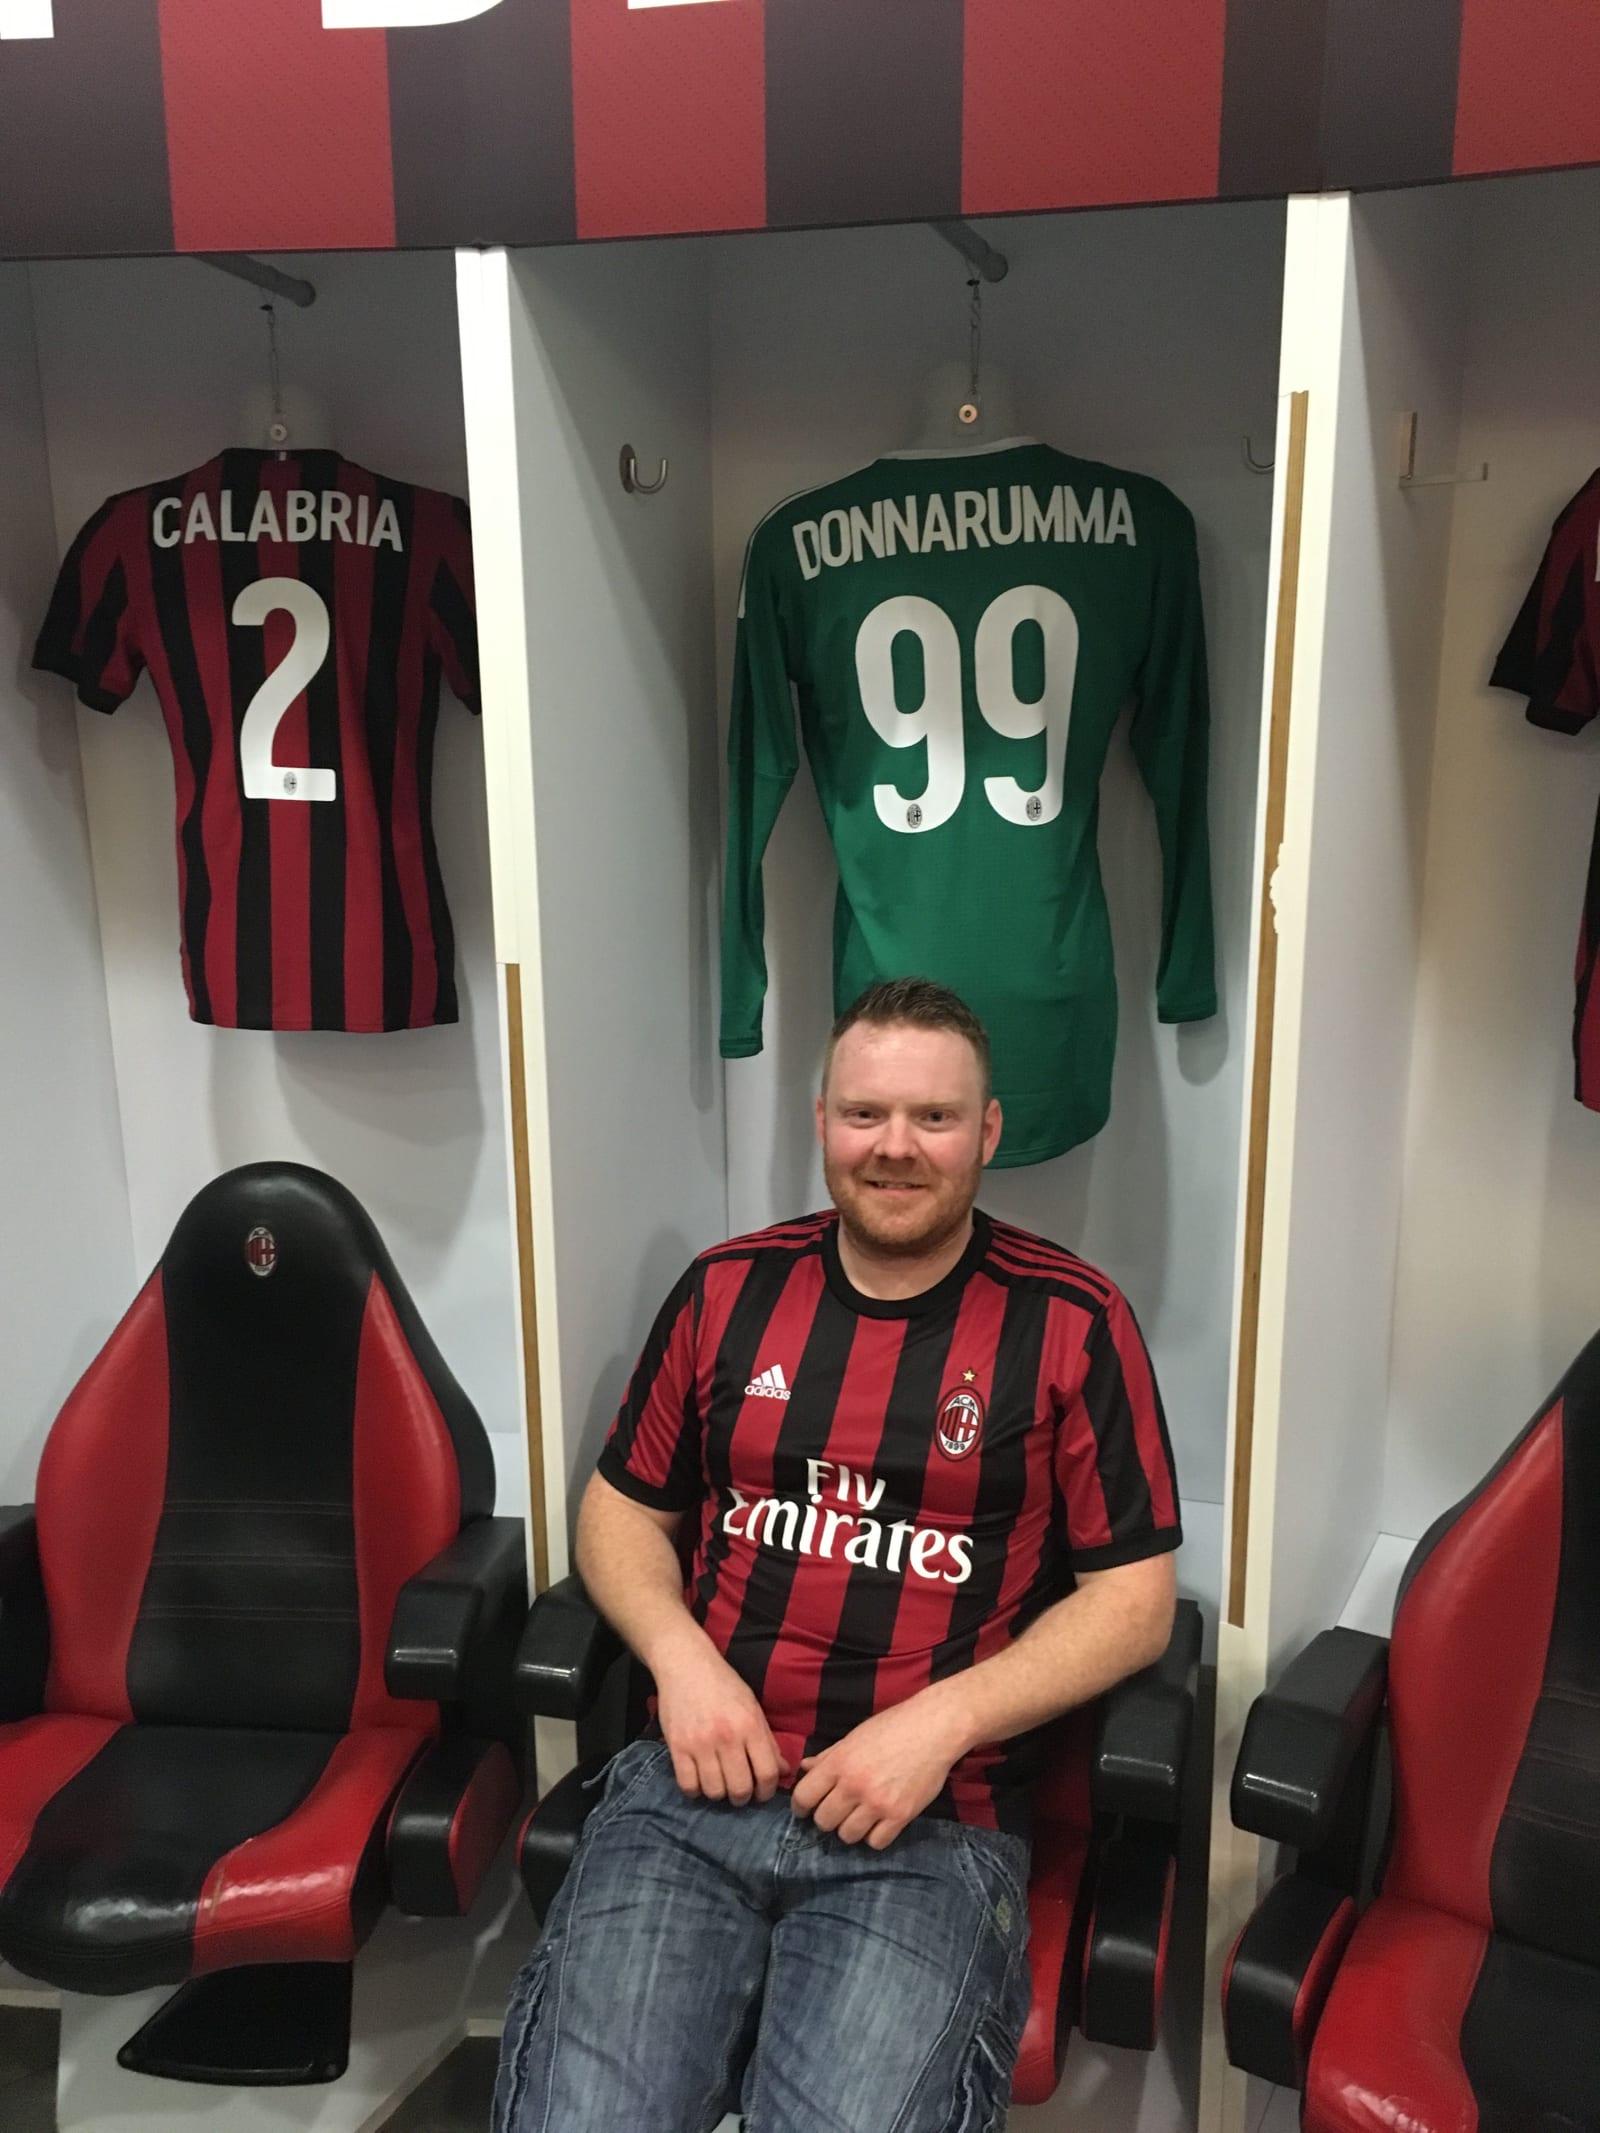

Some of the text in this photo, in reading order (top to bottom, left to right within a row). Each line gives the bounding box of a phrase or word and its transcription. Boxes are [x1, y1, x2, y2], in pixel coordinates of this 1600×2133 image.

[152, 490, 403, 552] CALABRIA
[793, 485, 1137, 580] DONNARUMMA
[231, 576, 336, 802] 2
[855, 584, 1079, 834] 99
[744, 1385, 791, 1401] adidas
[951, 1396, 976, 1411] ACM
[806, 1458, 886, 1510] Fly
[722, 1486, 974, 1584] Emirates
